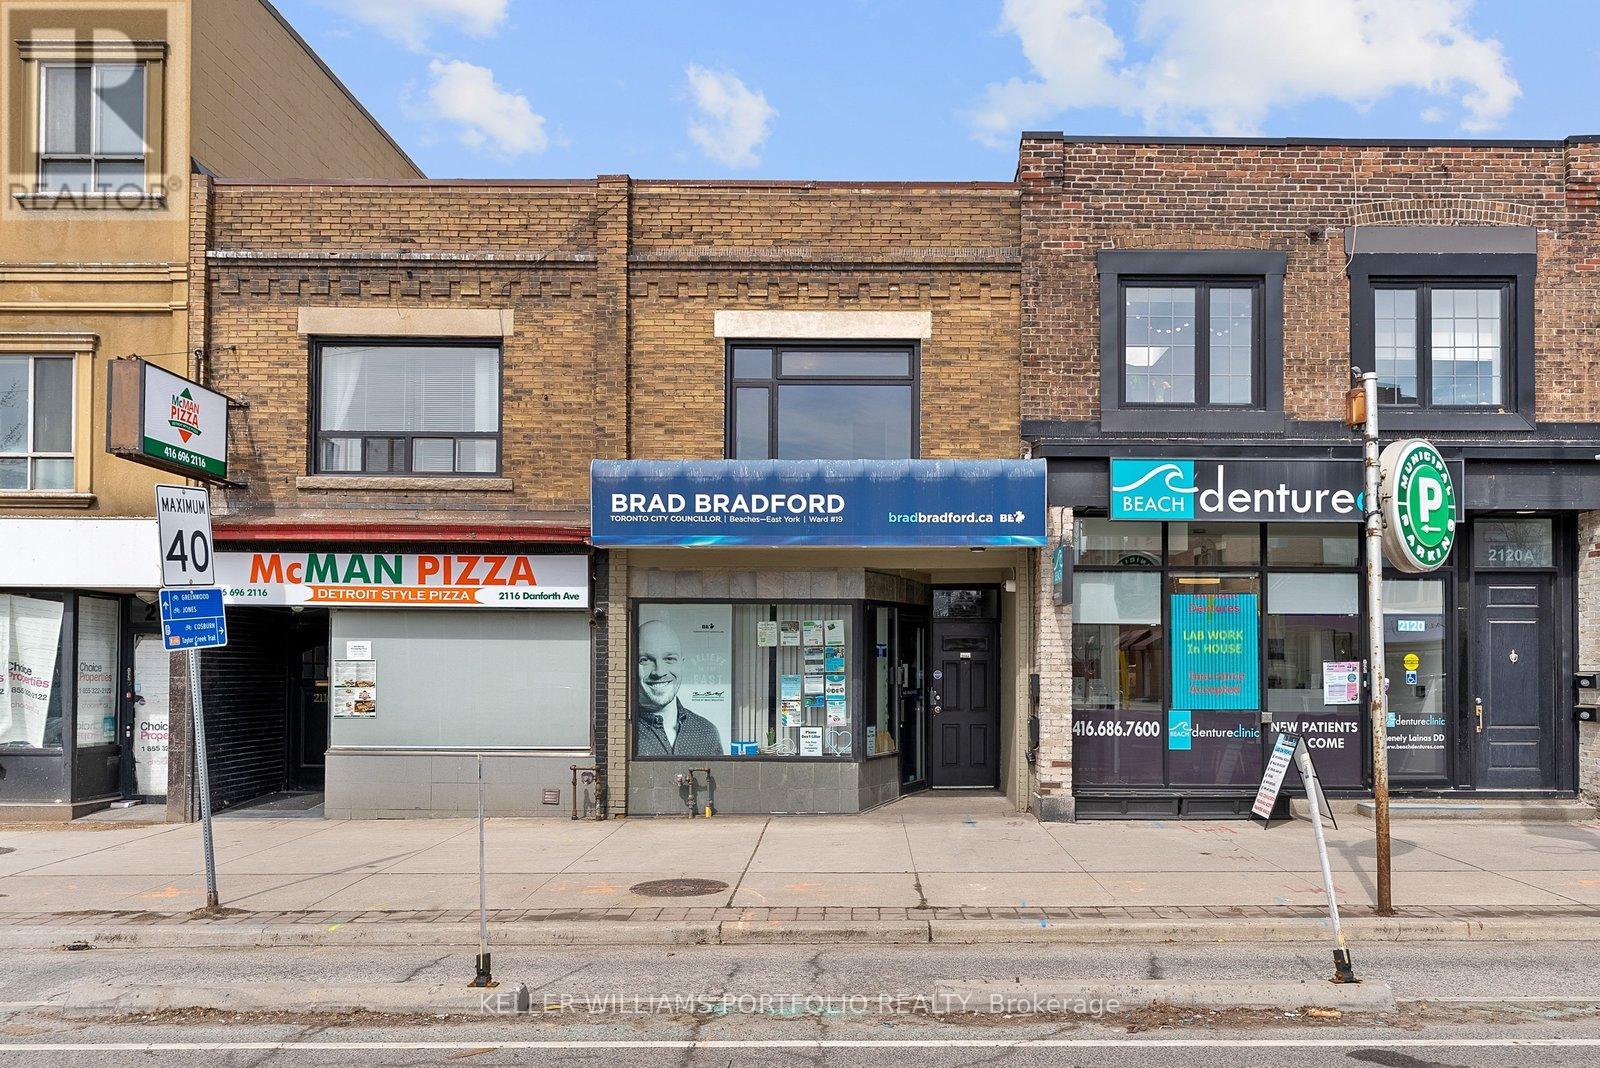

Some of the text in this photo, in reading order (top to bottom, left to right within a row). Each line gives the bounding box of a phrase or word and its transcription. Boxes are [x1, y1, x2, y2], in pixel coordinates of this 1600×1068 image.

[171, 394, 200, 414] McMAN
[171, 405, 199, 428] PIZZA
[164, 446, 206, 468] 416 696 2116
[1400, 451, 1453, 496] MUNICIPAL
[611, 493, 845, 514] BRAD BRADFORD
[1123, 496, 1184, 512] BEACH
[1418, 476, 1443, 523] P
[161, 497, 206, 515] MAXIMUM
[670, 515, 722, 523] COUNCILLOR
[784, 515, 801, 523] York
[809, 515, 829, 523] Ward
[830, 515, 844, 523] #19
[888, 512, 994, 524] bradbradford.ca
[1401, 514, 1455, 562] PARKING
[166, 529, 209, 573] 40
[1488, 549, 1534, 561] 2120A
[249, 553, 538, 586] McMAN PIZZA
[229, 588, 245, 597] 696
[247, 588, 268, 597] 2116
[317, 589, 471, 601] DETROIT STYLE PIZZA
[498, 592, 580, 601] 2116 Danforth Ave
[193, 623, 216, 631] COSBURN
[1398, 621, 1425, 631] 2120
[1183, 630, 1244, 641] LAB WORK
[1203, 644, 1242, 655] HOUSE
[8, 661, 32, 676] Chce
[79, 662, 102, 672] Choice
[8, 671, 50, 689] Proties
[79, 673, 112, 684] Properties
[140, 721, 168, 731] Choic
[1395, 714, 1446, 726] dentureclinic
[1072, 721, 1160, 737] 416.686.7600
[1191, 723, 1260, 738] dentureclinic
[1270, 722, 1358, 733] NEW PATIENTS
[140, 732, 168, 741] Prope
[1386, 734, 1407, 743] enely
[1433, 734, 1445, 742] DD
[1307, 738, 1345, 748] COME
